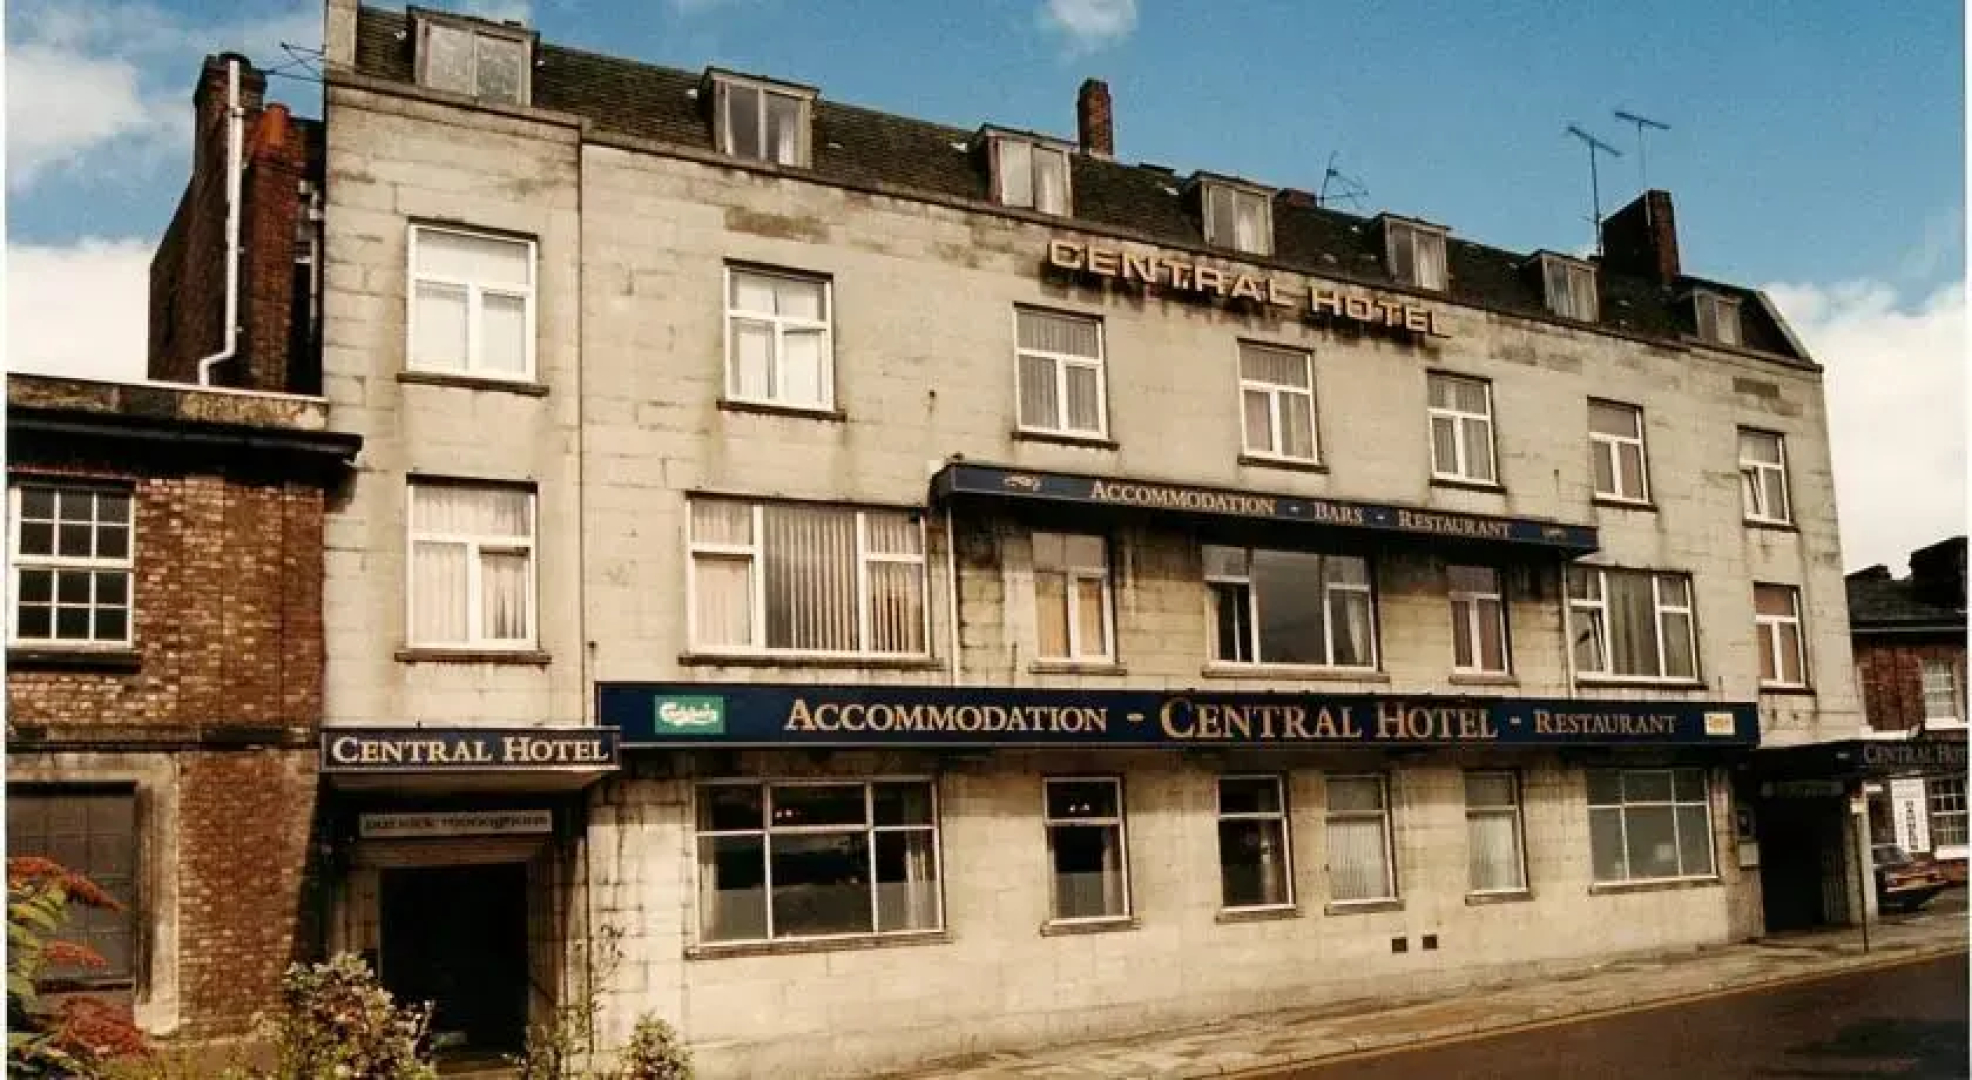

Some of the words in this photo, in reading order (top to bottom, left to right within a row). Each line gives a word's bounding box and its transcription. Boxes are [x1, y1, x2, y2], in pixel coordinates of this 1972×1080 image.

[1047, 238, 1297, 306] CENTRAL
[1310, 286, 1451, 339] HOTEL
[1089, 477, 1277, 516] ACCOMMODATION
[1313, 502, 1364, 526] BARS
[1398, 509, 1511, 539] RESTAURANT
[783, 699, 1107, 732] ACCOMMODATION
[1160, 699, 1363, 739] CENTRAL
[1376, 706, 1499, 739] HOTEL
[1535, 710, 1676, 734] RESTAURANT
[332, 736, 493, 764] CENTRAL
[501, 736, 610, 762] HOTEL
